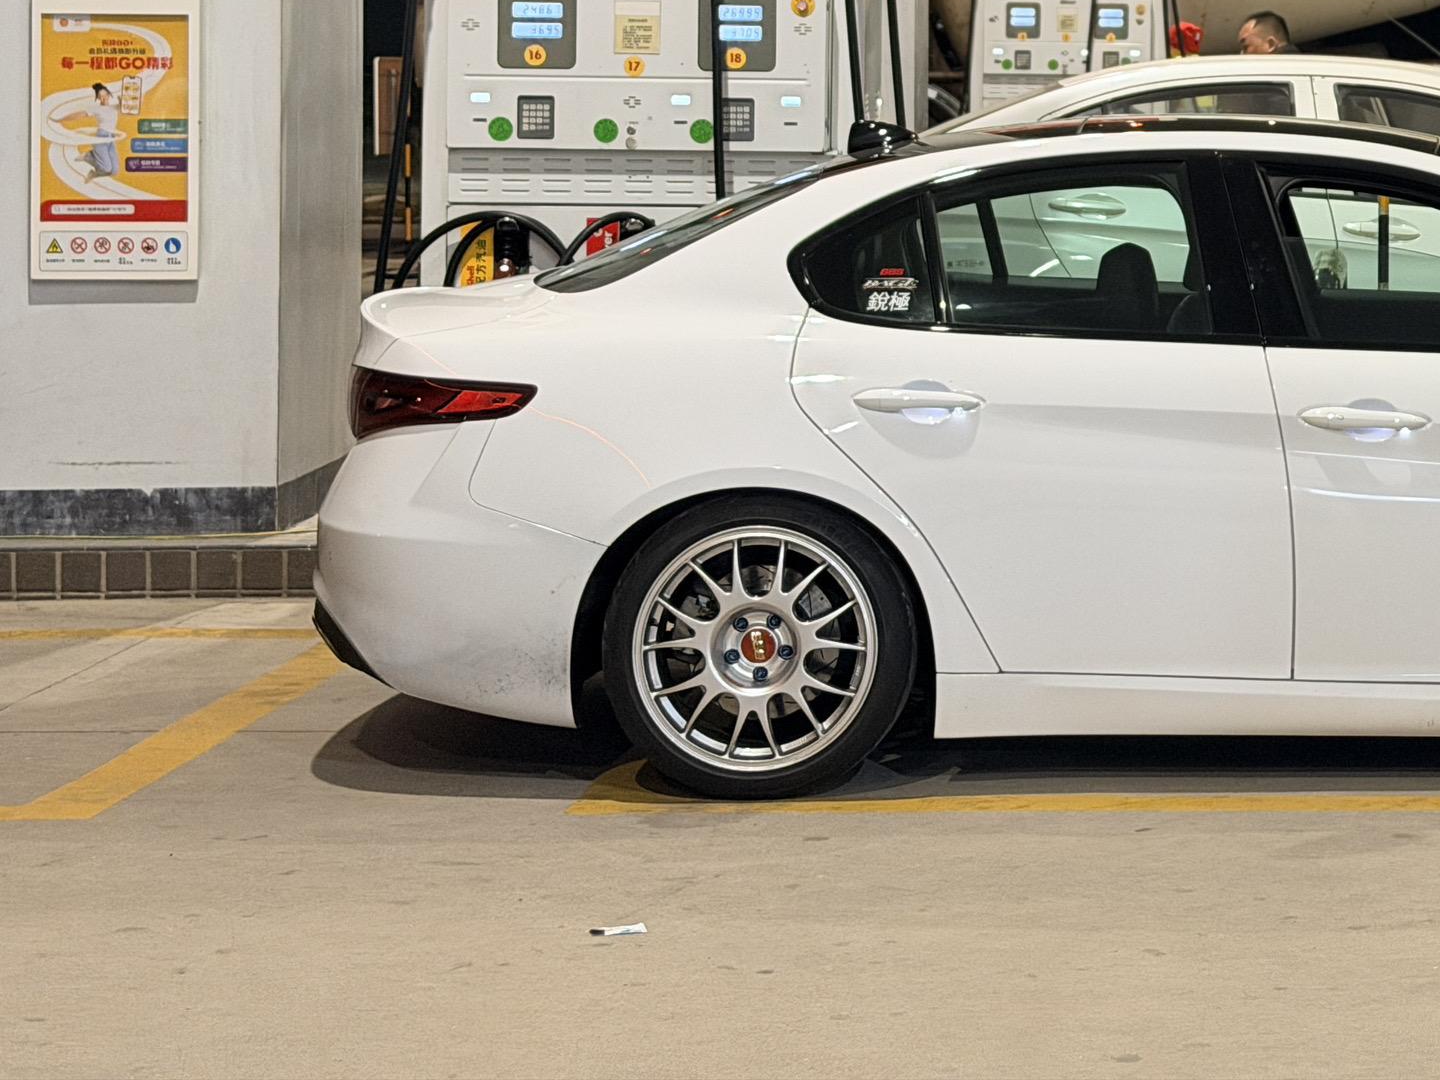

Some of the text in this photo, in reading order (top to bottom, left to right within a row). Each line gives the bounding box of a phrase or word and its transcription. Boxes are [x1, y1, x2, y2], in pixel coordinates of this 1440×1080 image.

[528, 49, 542, 60] 16
[729, 52, 742, 64] 18
[628, 61, 640, 71] 17
